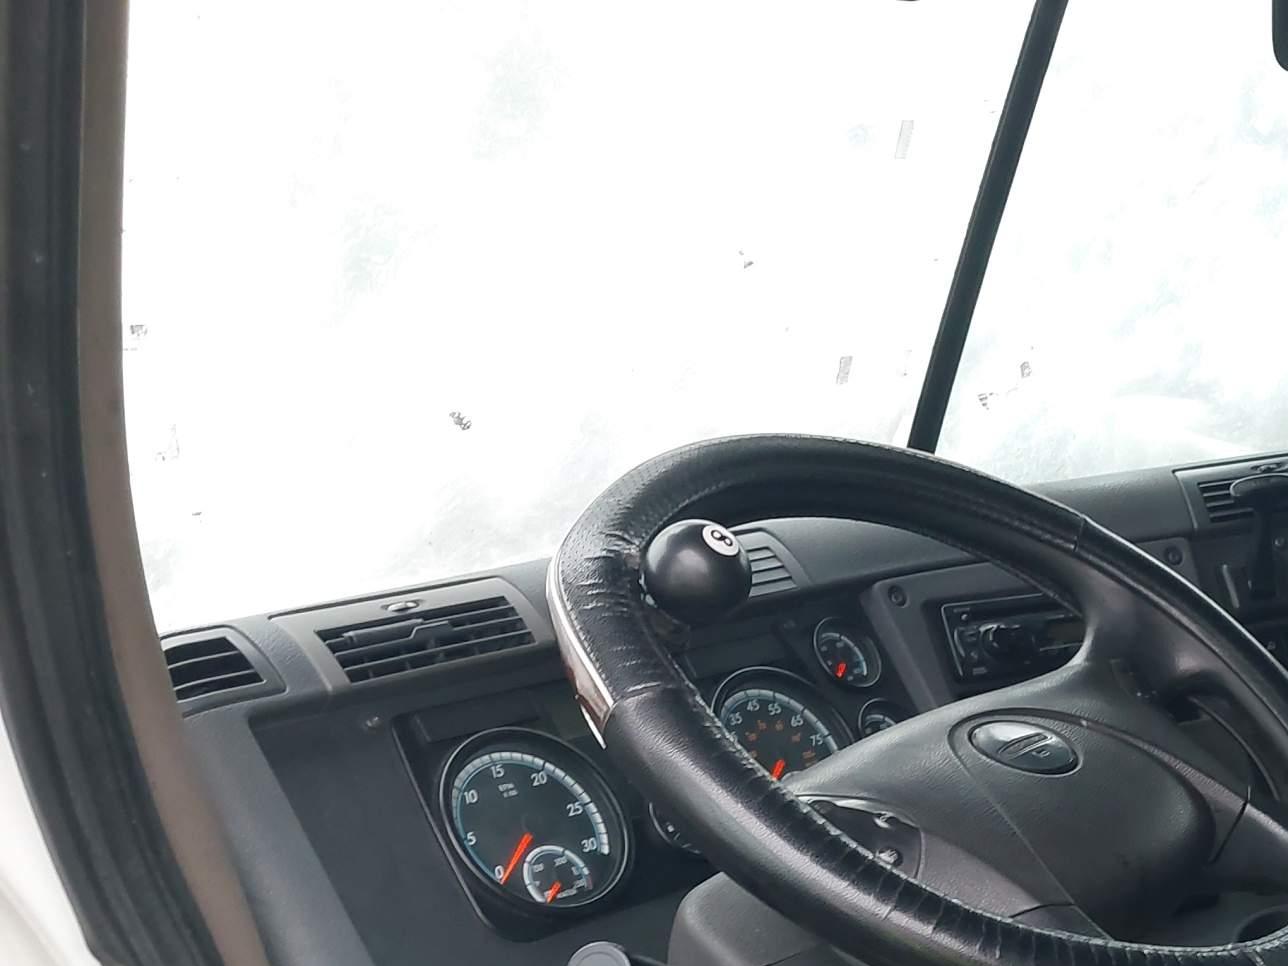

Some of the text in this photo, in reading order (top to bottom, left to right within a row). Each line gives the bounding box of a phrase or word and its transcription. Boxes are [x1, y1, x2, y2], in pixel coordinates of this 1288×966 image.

[711, 530, 734, 547] 8
[746, 699, 760, 712] 45
[768, 702, 782, 716] 55
[728, 711, 743, 726] 35
[790, 714, 804, 727] 65
[810, 735, 823, 747] 75
[490, 764, 505, 779] 15
[530, 771, 548, 787] 20
[463, 789, 479, 804] 10
[566, 801, 584, 817] 25
[466, 831, 477, 846] 5
[581, 837, 597, 853] 30
[494, 864, 504, 880] 0
